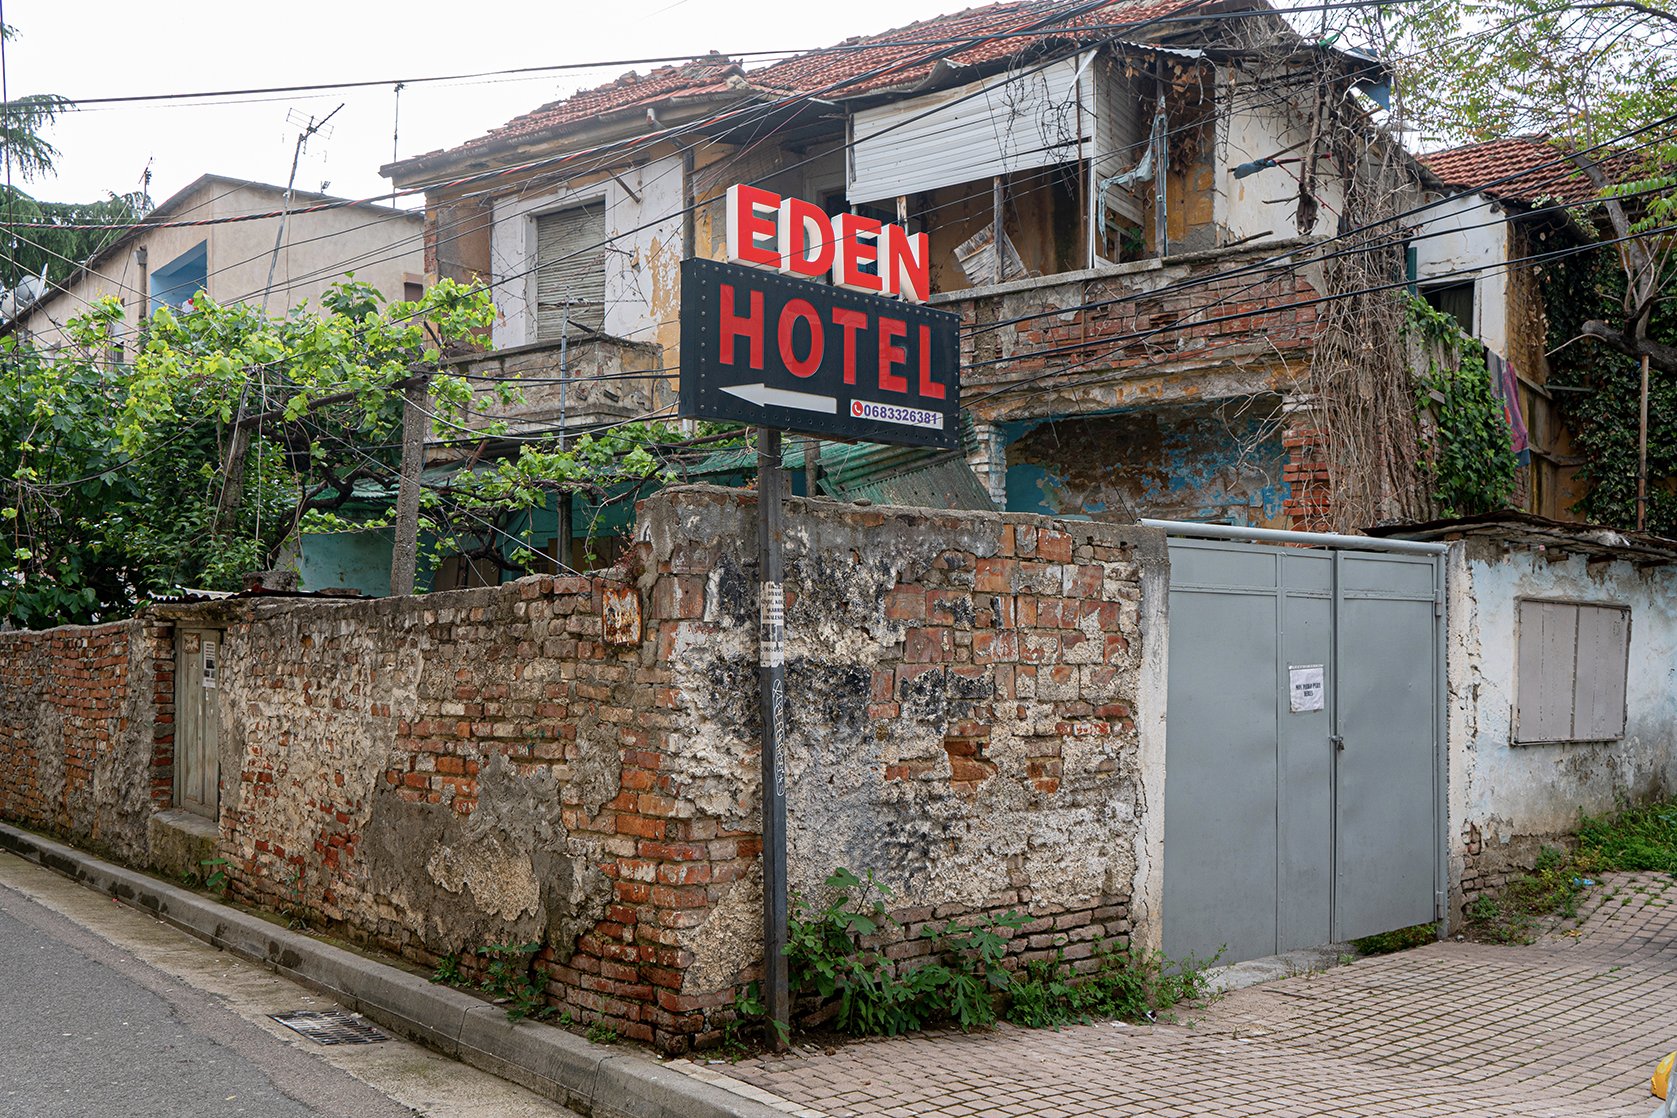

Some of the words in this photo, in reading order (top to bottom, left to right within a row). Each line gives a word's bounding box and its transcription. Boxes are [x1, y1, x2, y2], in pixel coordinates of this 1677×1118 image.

[727, 183, 930, 305] EDEN
[719, 283, 946, 400] HOTEL
[863, 403, 938, 425] 0683326381
